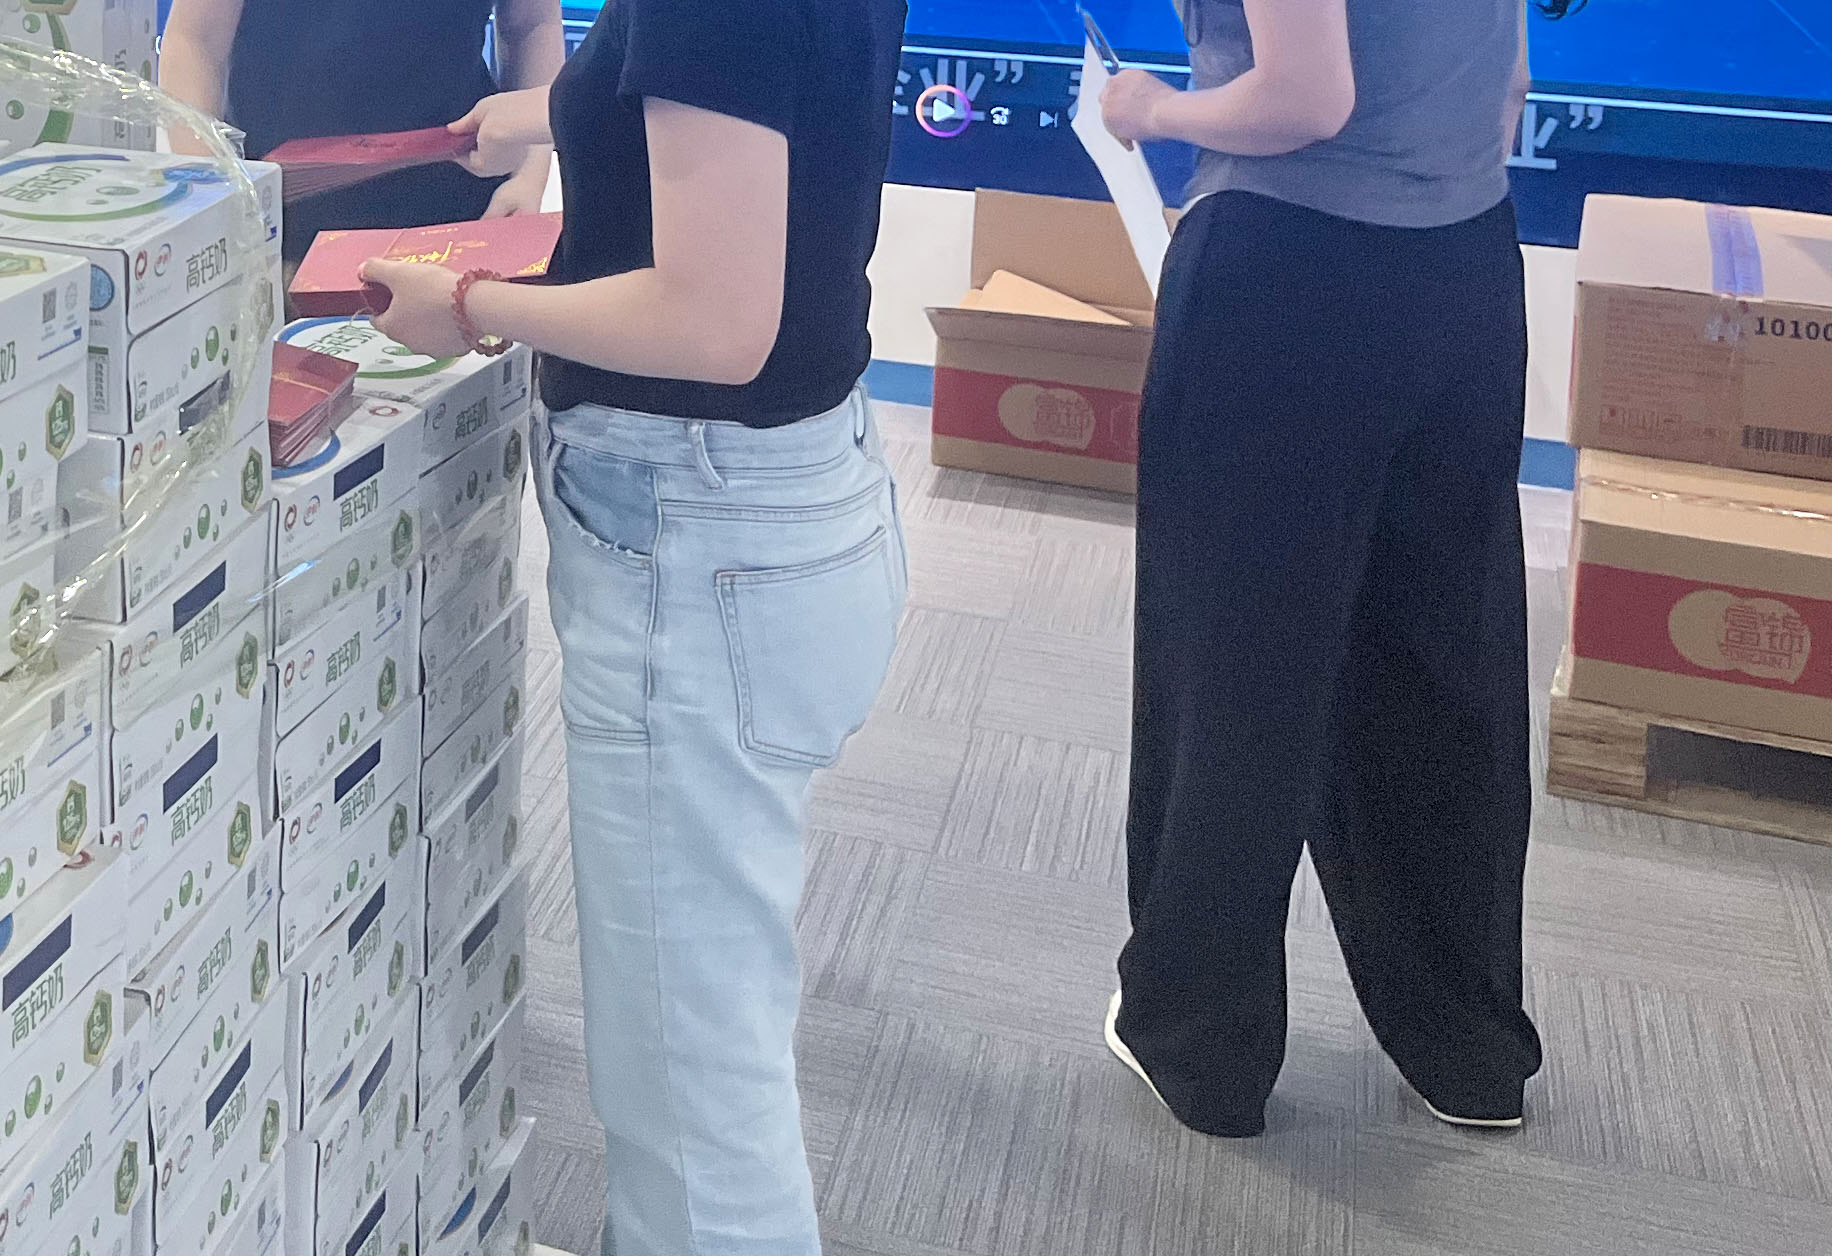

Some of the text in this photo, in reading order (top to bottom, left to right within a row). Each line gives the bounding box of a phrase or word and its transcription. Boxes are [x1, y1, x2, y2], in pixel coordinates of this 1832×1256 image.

[186, 236, 228, 293] 高钙奶
[339, 478, 379, 533] 高钙奶
[178, 601, 220, 669] 高钙奶
[170, 774, 213, 844] 高钙奶
[11, 962, 65, 1048] 高钙奶
[50, 1131, 93, 1219] 高钙奶
